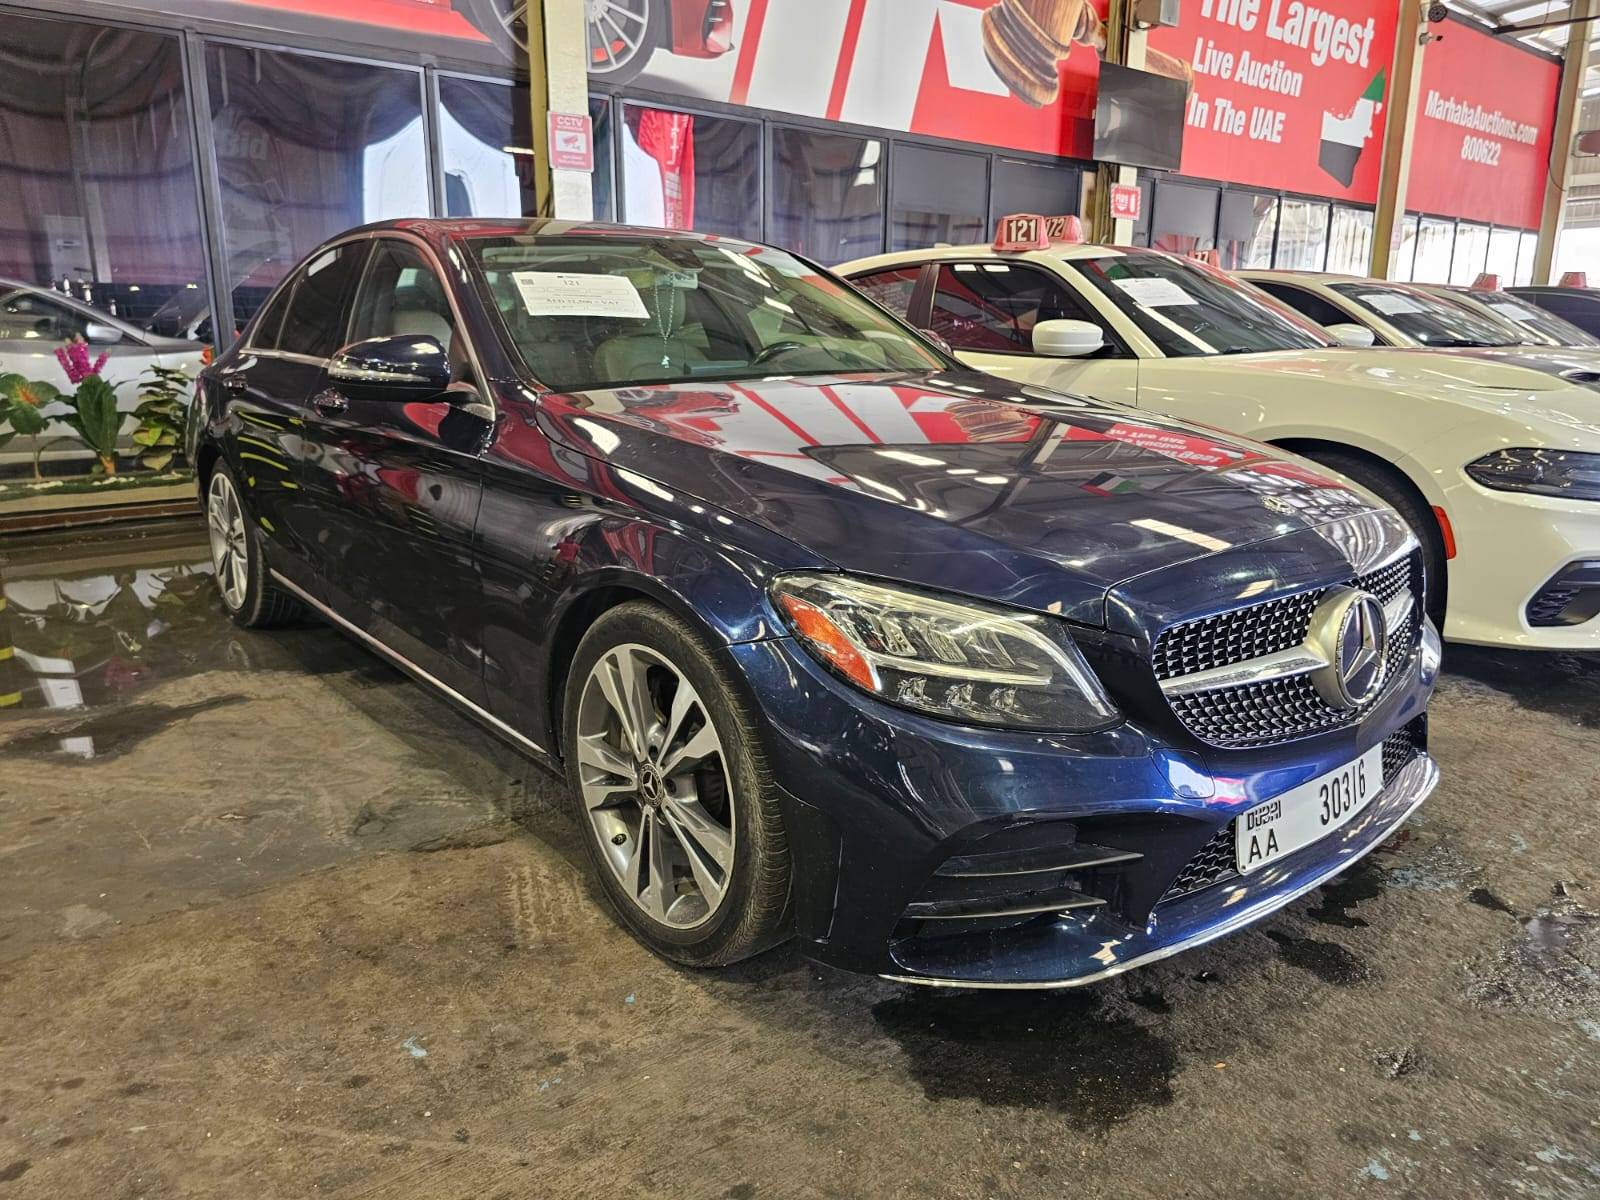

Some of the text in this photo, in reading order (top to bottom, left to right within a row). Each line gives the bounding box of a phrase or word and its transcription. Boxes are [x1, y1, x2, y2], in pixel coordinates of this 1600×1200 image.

[1266, 0, 1375, 68] Largest
[1191, 37, 1303, 97] Live Auction
[557, 116, 584, 128] CCTV
[1187, 92, 1286, 143] In The UAE
[1424, 89, 1538, 145] MarhabaAuctions.com
[1461, 134, 1502, 166] 800622
[1009, 219, 1036, 242] 121
[1319, 758, 1366, 826] 30316
[1248, 827, 1279, 864] AA
